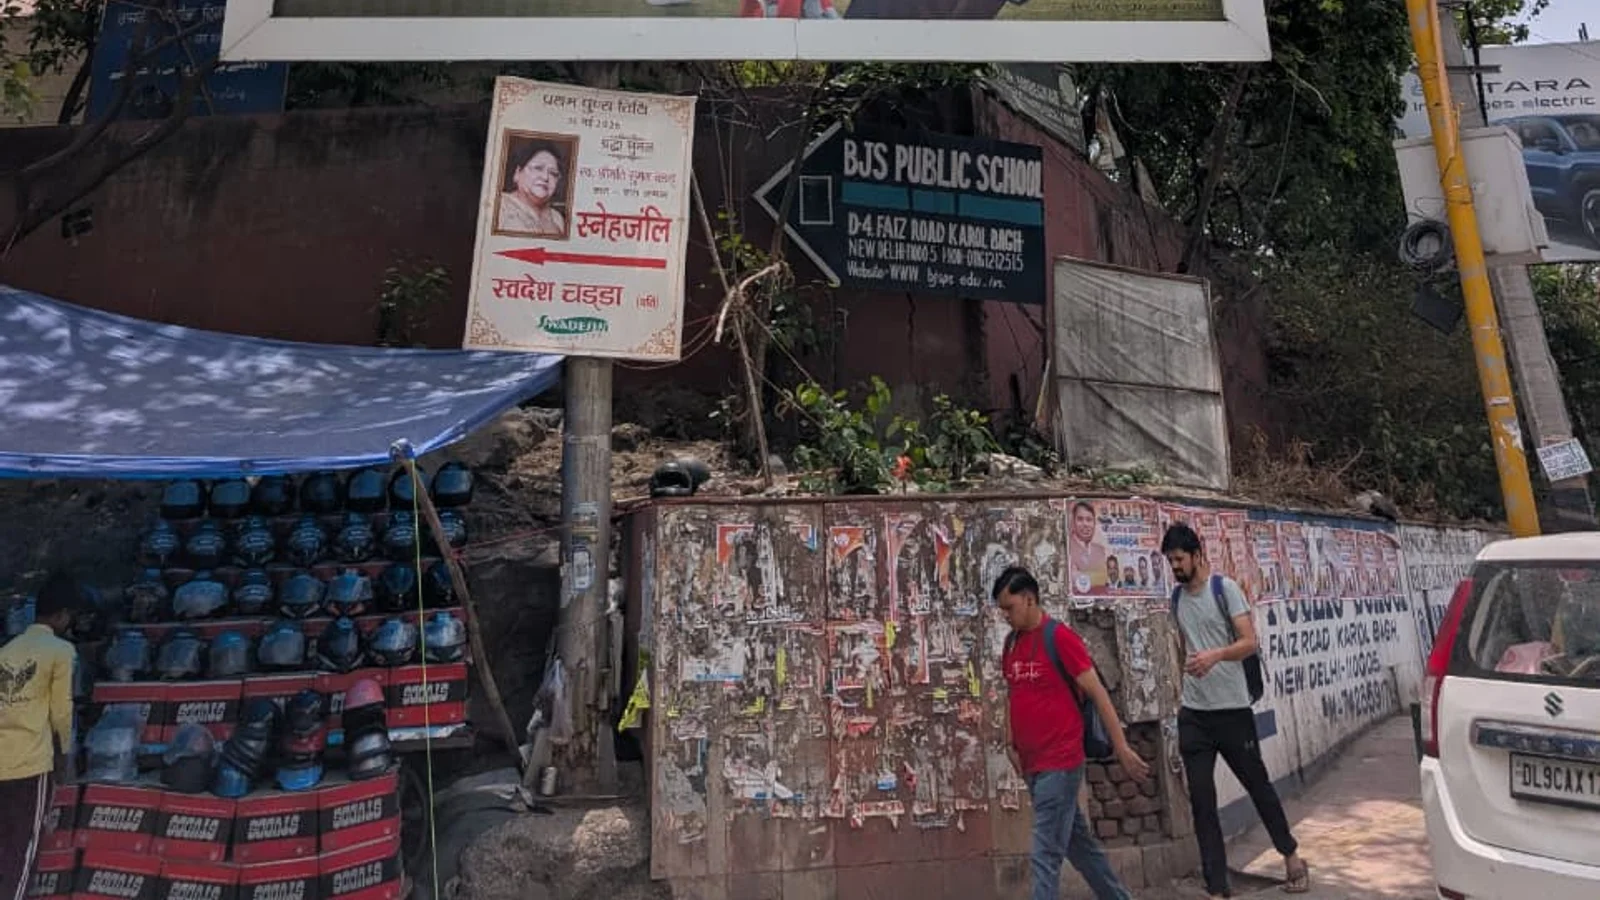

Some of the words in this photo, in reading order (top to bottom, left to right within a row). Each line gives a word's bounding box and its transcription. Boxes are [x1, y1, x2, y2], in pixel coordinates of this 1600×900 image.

[1483, 78, 1592, 93] TARA
[1523, 96, 1597, 109] electric
[843, 138, 889, 181] BJS
[895, 143, 971, 190] PUBLIC
[976, 153, 1044, 199] SCHOOL
[849, 238, 876, 259] NEW
[876, 214, 907, 240] FAIZ
[910, 218, 945, 243] ROAD
[948, 222, 988, 249] KAROL
[990, 228, 1024, 252] BAGH
[491, 273, 556, 302] स्वदेश
[1269, 632, 1299, 661] FAIZ
[1301, 627, 1330, 654] ROAD
[1337, 621, 1370, 649] KAROL
[1274, 665, 1304, 698] NEW
